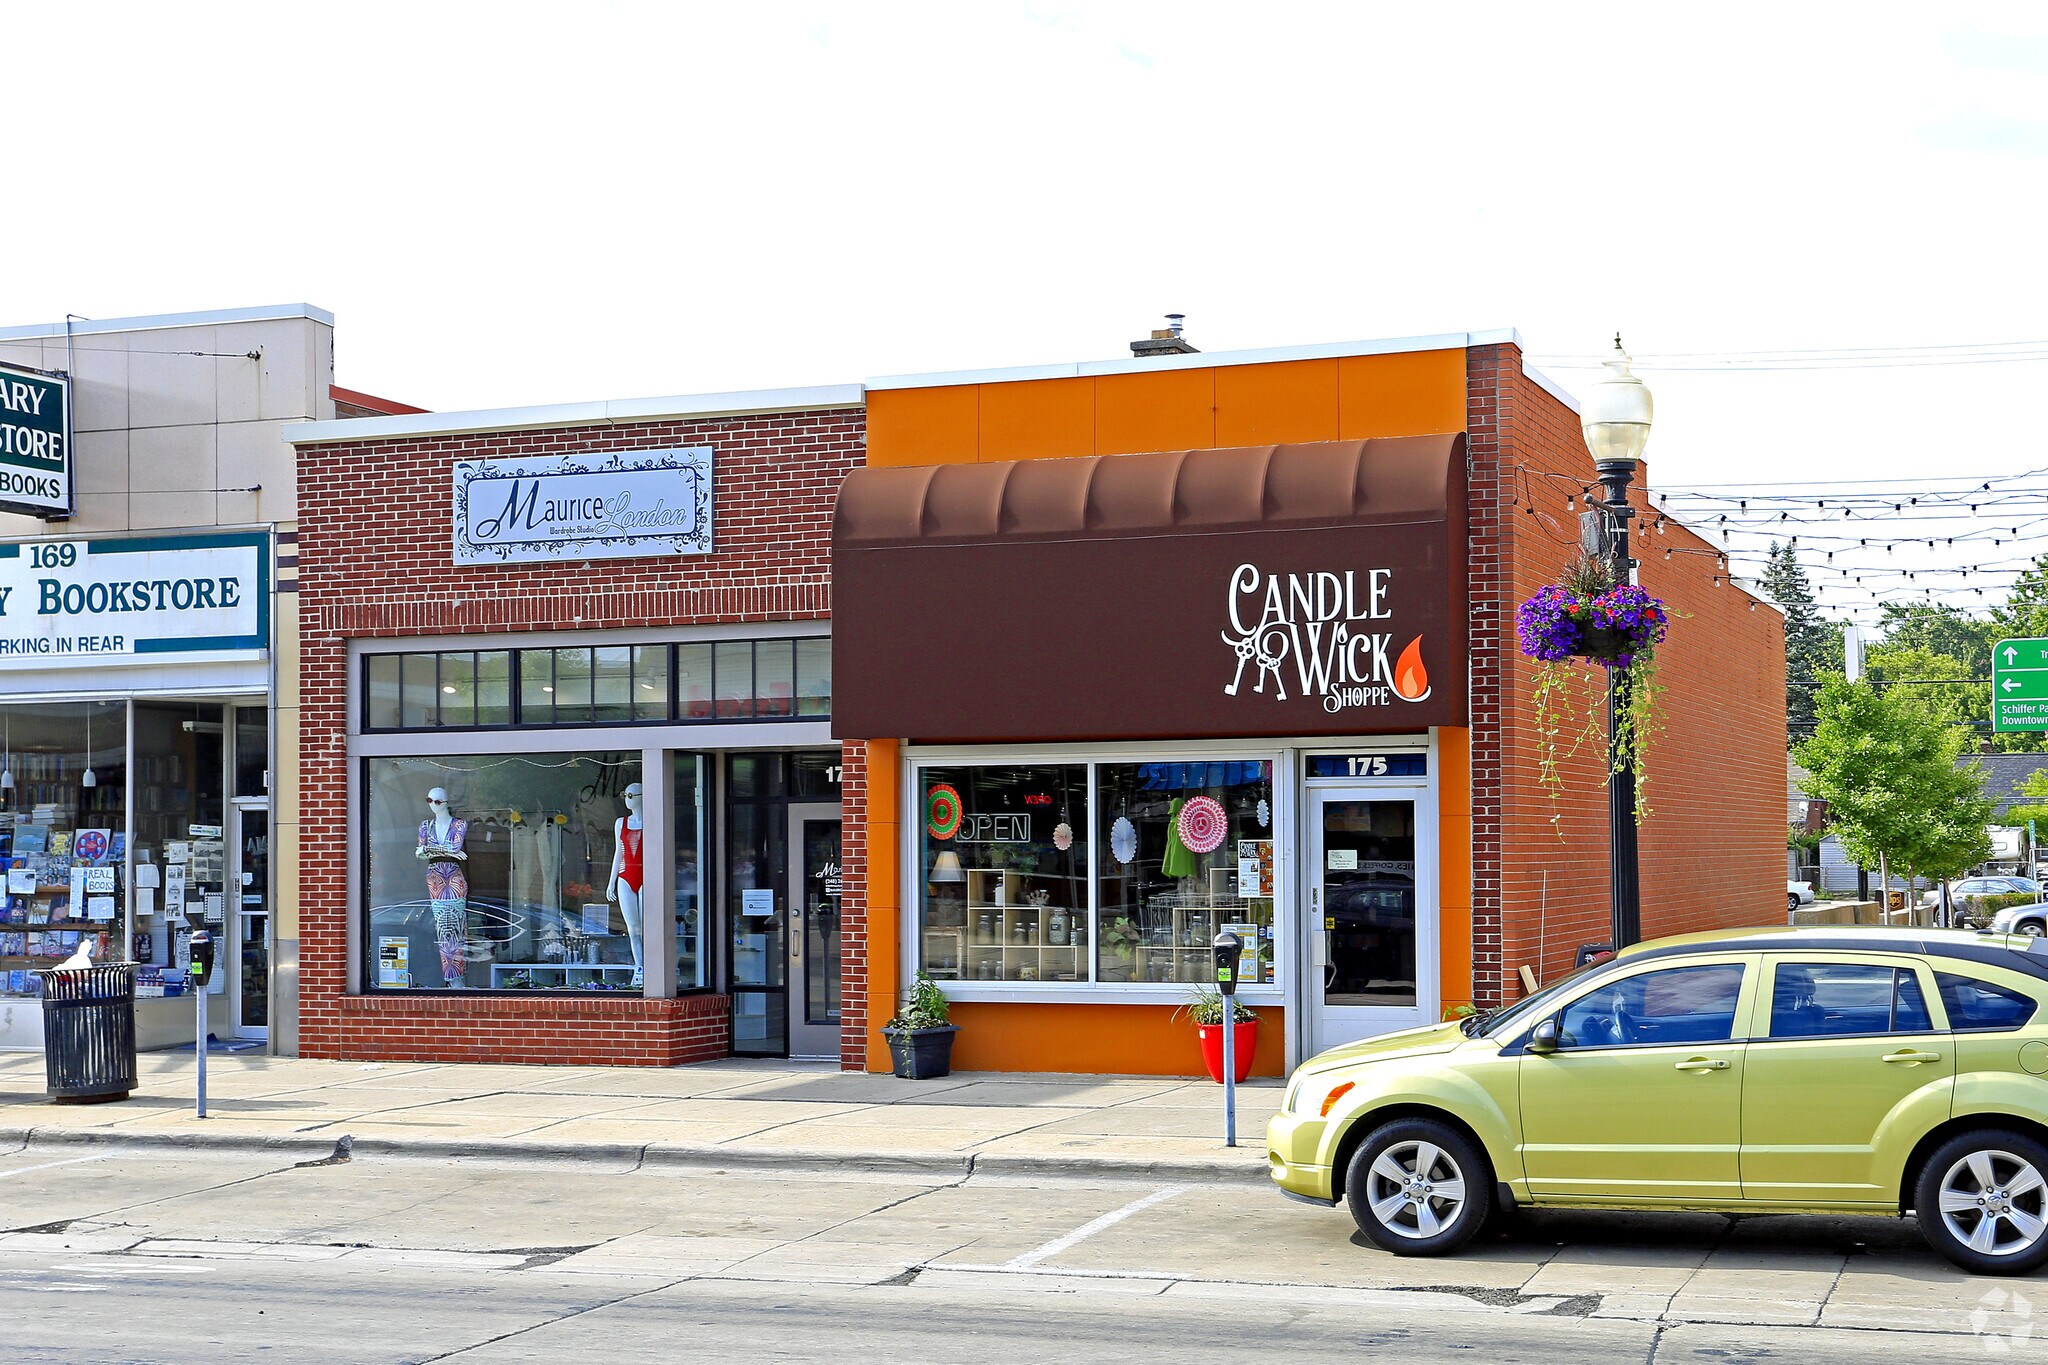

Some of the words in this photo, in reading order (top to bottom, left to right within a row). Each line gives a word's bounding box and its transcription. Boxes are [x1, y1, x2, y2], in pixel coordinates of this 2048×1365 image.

[0, 423, 62, 461] TORE
[0, 471, 60, 499] BOOKS
[476, 479, 604, 539] Maurice
[595, 490, 687, 540] London
[577, 525, 595, 534] Studio
[30, 543, 77, 569] 169
[37, 577, 241, 615] BOOKSTORE
[1228, 563, 1393, 636] CANDLE
[56, 637, 72, 652] IN
[78, 635, 124, 652] REAR
[1323, 683, 1390, 713] SHOPPE
[2002, 704, 2036, 714] Schiffer
[1347, 756, 1388, 776] 175
[959, 816, 1027, 840] OPEN
[88, 869, 113, 879] REAL
[88, 881, 115, 891] BOOKS
